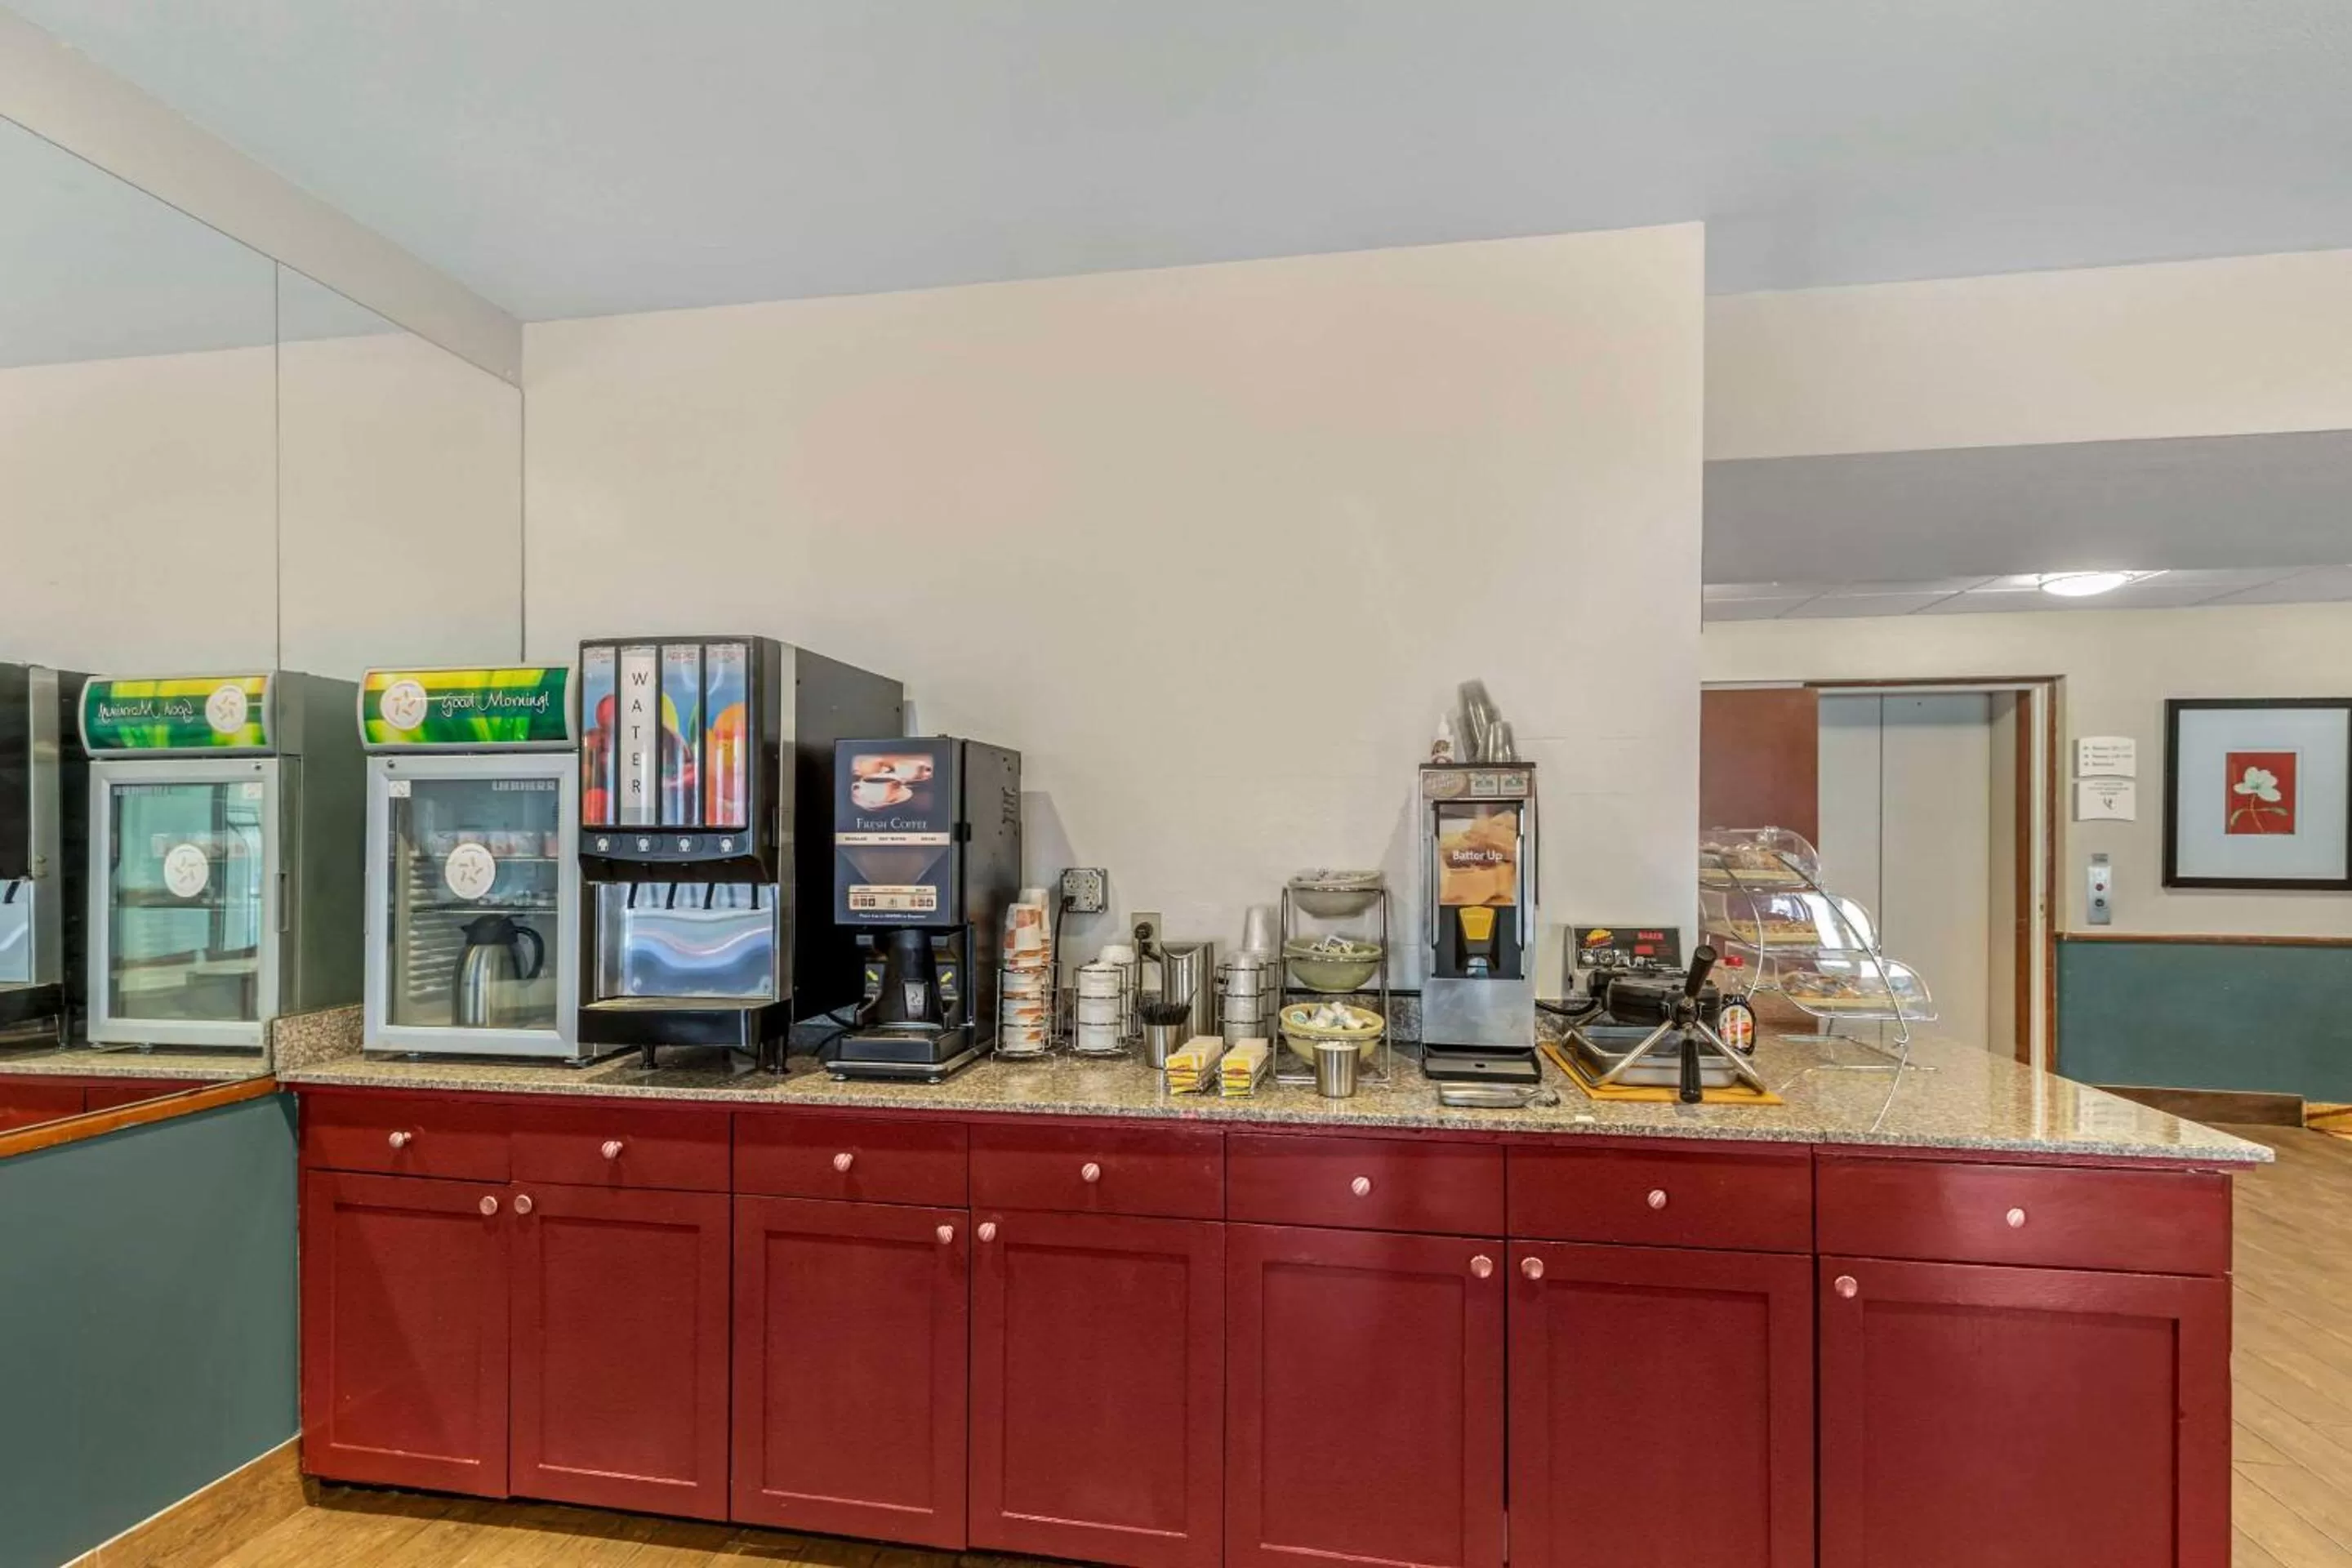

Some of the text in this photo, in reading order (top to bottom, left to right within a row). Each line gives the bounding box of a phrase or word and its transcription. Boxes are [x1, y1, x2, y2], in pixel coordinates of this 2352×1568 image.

[440, 691, 550, 717] Good Morning!
[631, 672, 648, 794] WATER
[1452, 849, 1503, 863] Batter Up
